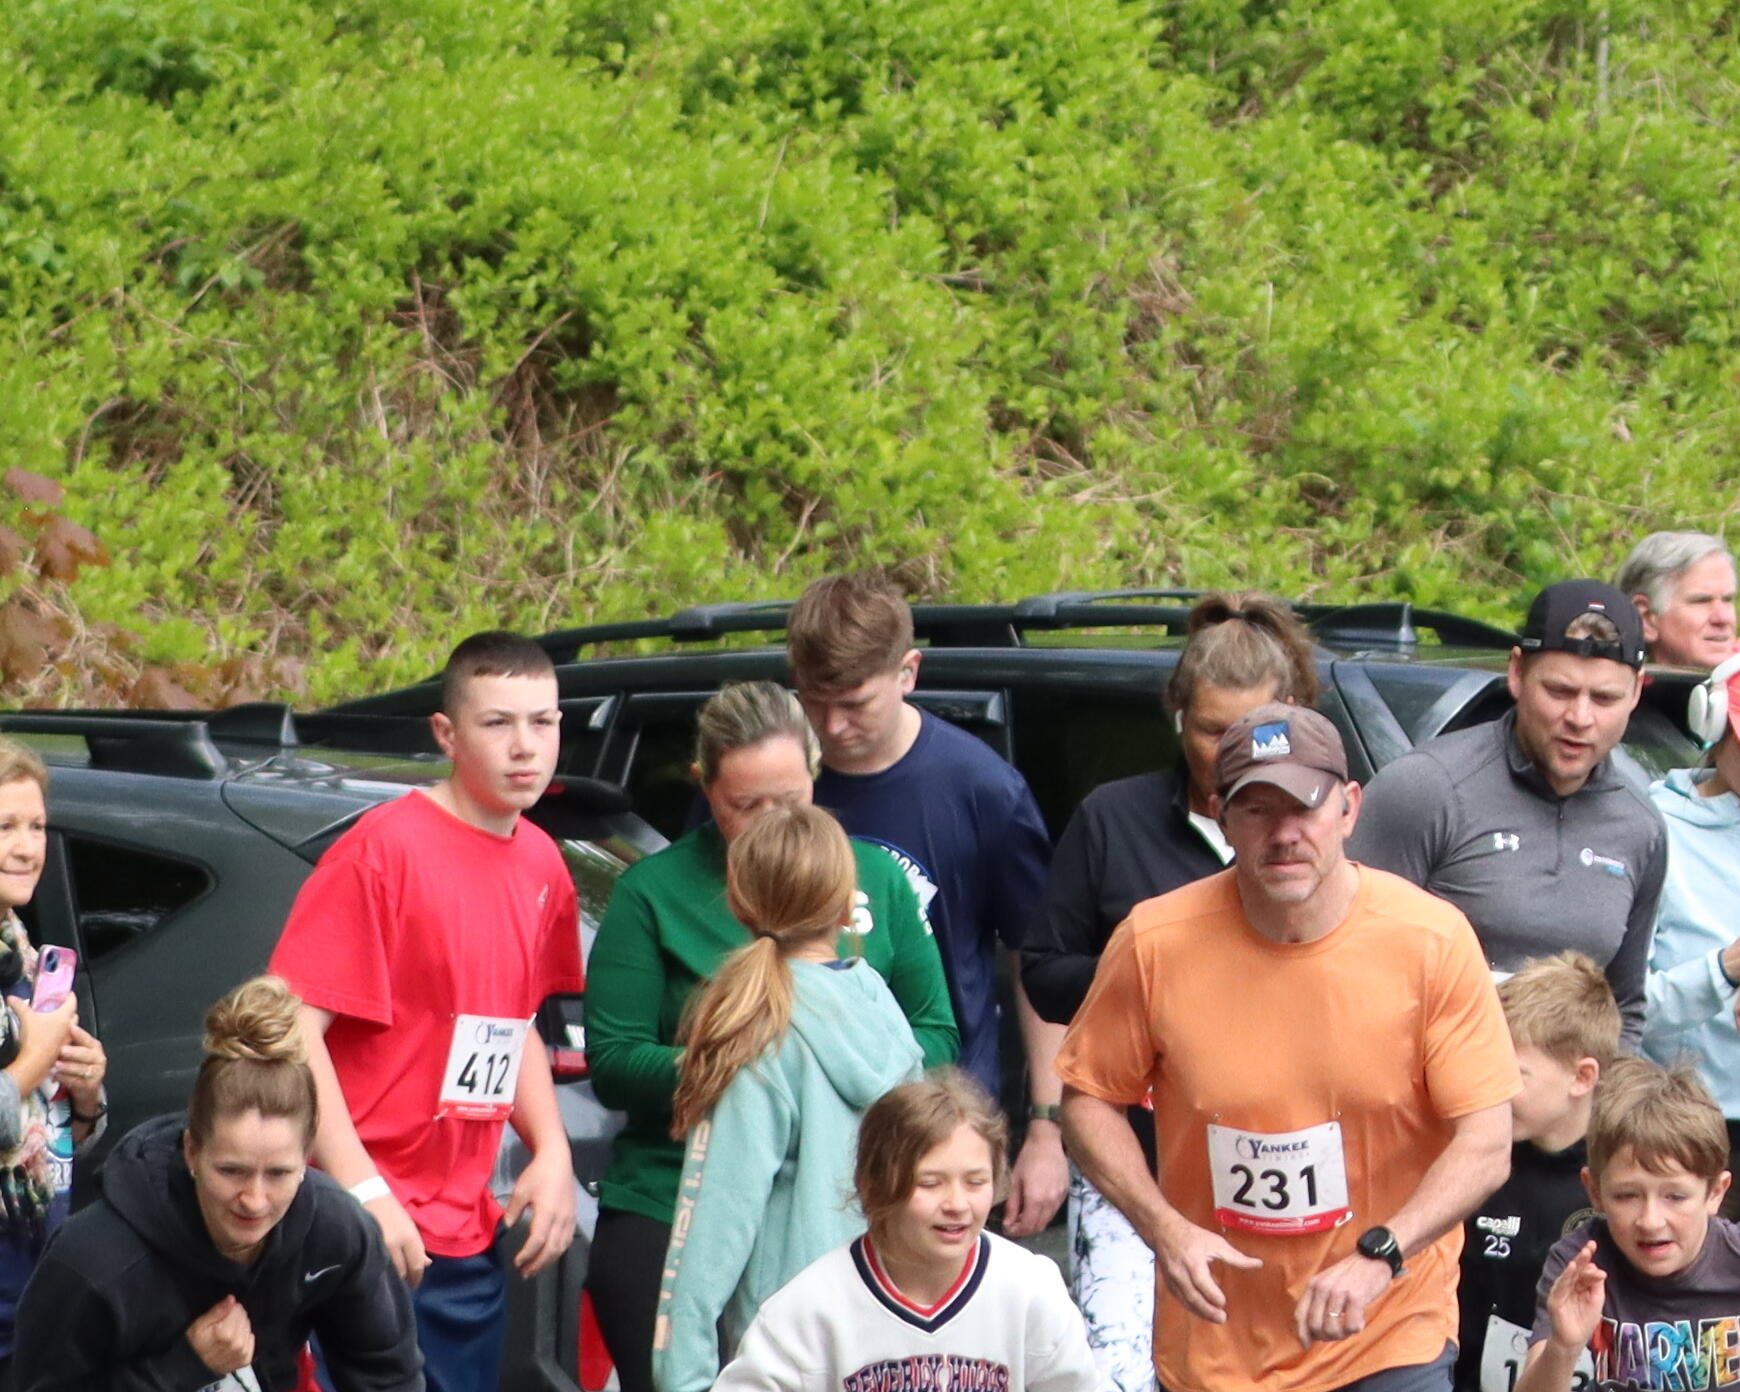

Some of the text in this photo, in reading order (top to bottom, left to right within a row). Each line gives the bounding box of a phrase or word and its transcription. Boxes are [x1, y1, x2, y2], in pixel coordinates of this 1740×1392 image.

[456, 1051, 511, 1095] 412
[1248, 1138, 1309, 1159] YANKEE
[1229, 1163, 1318, 1210] 231
[1483, 1235, 1511, 1258] 25
